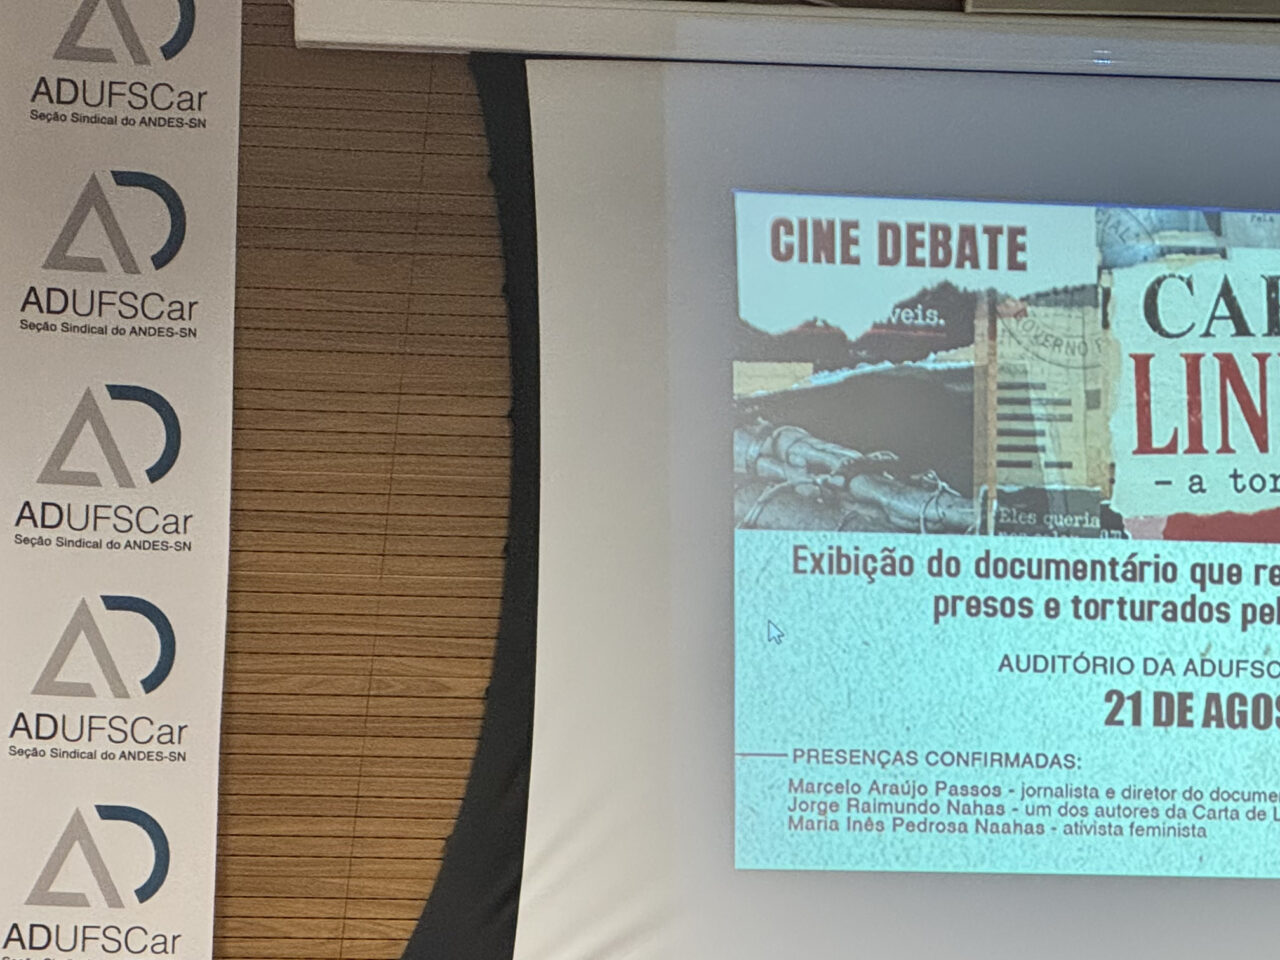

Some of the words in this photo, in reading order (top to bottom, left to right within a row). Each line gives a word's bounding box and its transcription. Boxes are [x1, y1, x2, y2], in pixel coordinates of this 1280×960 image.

[31, 76, 207, 111] ADUFSCar
[770, 217, 860, 265] CINE
[877, 220, 1027, 270] DEBATE
[21, 286, 198, 321] ADUFSCar
[20, 319, 57, 333] Seção
[61, 321, 107, 335] Sindical
[111, 325, 126, 336] do
[129, 326, 196, 338] ANDES-SN
[1188, 473, 1207, 493] a
[15, 500, 192, 535] ADUFSCar
[15, 534, 51, 547] Seção
[56, 536, 102, 549] Sindical
[106, 540, 121, 550] do
[124, 539, 191, 552] ANDES-SN
[794, 544, 914, 584] Exibição
[928, 548, 960, 578] do
[975, 549, 1177, 583] documentário
[1191, 562, 1242, 592] que
[934, 595, 1033, 625] presos
[1045, 598, 1060, 620] e
[1071, 595, 1230, 623] torturados
[998, 651, 1134, 676] AUDITÓRIO
[1143, 657, 1175, 677] DA
[1105, 689, 1141, 727] 21
[1153, 691, 1193, 728] DE
[10, 712, 188, 745] ADUFSCar
[793, 748, 918, 769] PRESENÇAS
[925, 750, 1081, 769] CONFIRMADAS:
[789, 778, 861, 796] Marcelo
[868, 779, 928, 801] Araújo
[935, 780, 1001, 799] Passos
[1021, 781, 1099, 804] jornalista
[1106, 787, 1115, 800] e
[1121, 784, 1176, 801] diretor
[1182, 785, 1203, 802] do
[788, 798, 839, 819] Jorge
[847, 799, 940, 816] Raimundo
[947, 800, 1005, 818] Nahas
[1026, 804, 1051, 817] um
[1058, 802, 1088, 819] dos
[1095, 804, 1159, 820] autores
[1165, 804, 1186, 820] da
[1193, 804, 1239, 821] Carta
[1246, 805, 1266, 821] de
[789, 816, 839, 831] Maria
[847, 817, 884, 832] Inês
[893, 817, 968, 833] Pedrosa
[975, 819, 1045, 836] Naahas
[1064, 820, 1123, 837] ativista
[1130, 821, 1207, 838] feminista
[3, 923, 181, 955] ADUFSCar
